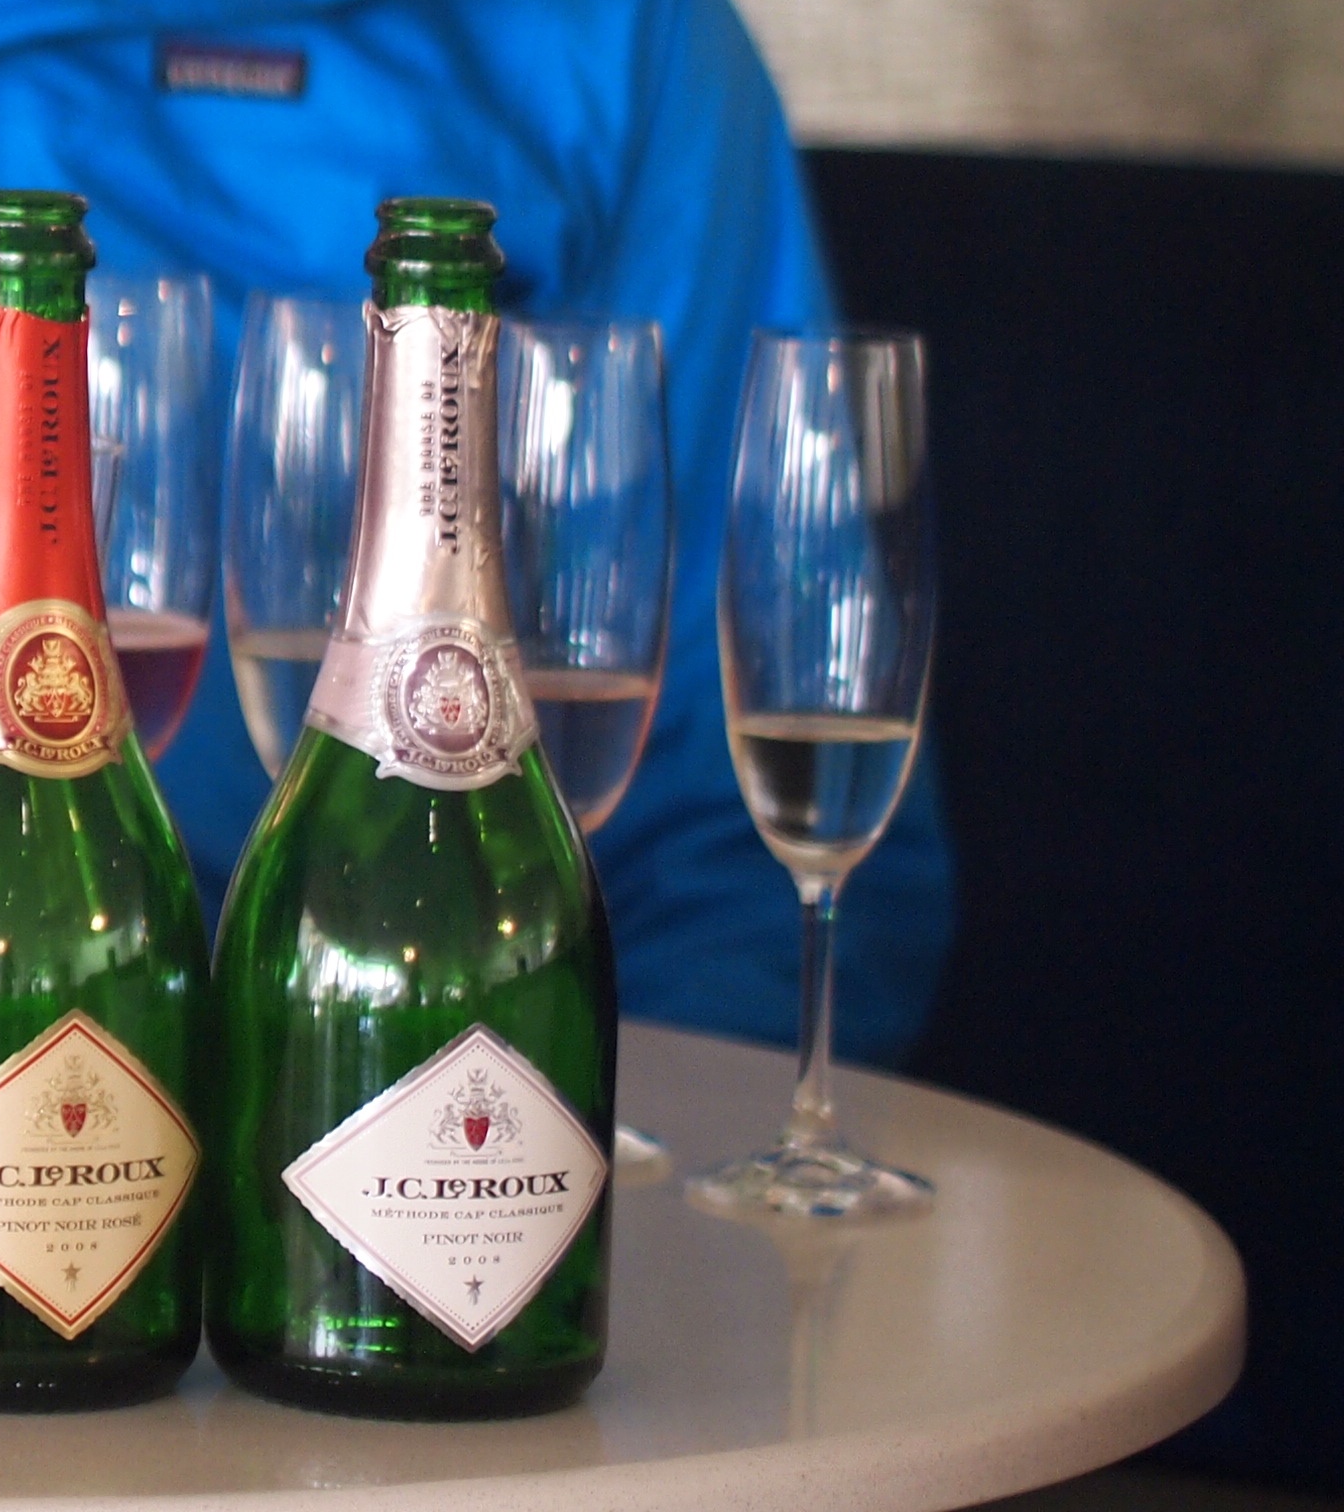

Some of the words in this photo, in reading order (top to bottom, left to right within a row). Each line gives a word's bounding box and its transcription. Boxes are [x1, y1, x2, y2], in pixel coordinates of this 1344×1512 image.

[51, 1196, 82, 1207] CAP
[85, 1189, 160, 1206] CLASSIQUE
[453, 1208, 485, 1220] CAP
[488, 1203, 564, 1219] CLASSIQUE
[54, 1219, 97, 1232] NOIR
[101, 1212, 142, 1229] ROSÉ
[422, 1232, 479, 1245] PINOT
[482, 1231, 524, 1244] NOIR
